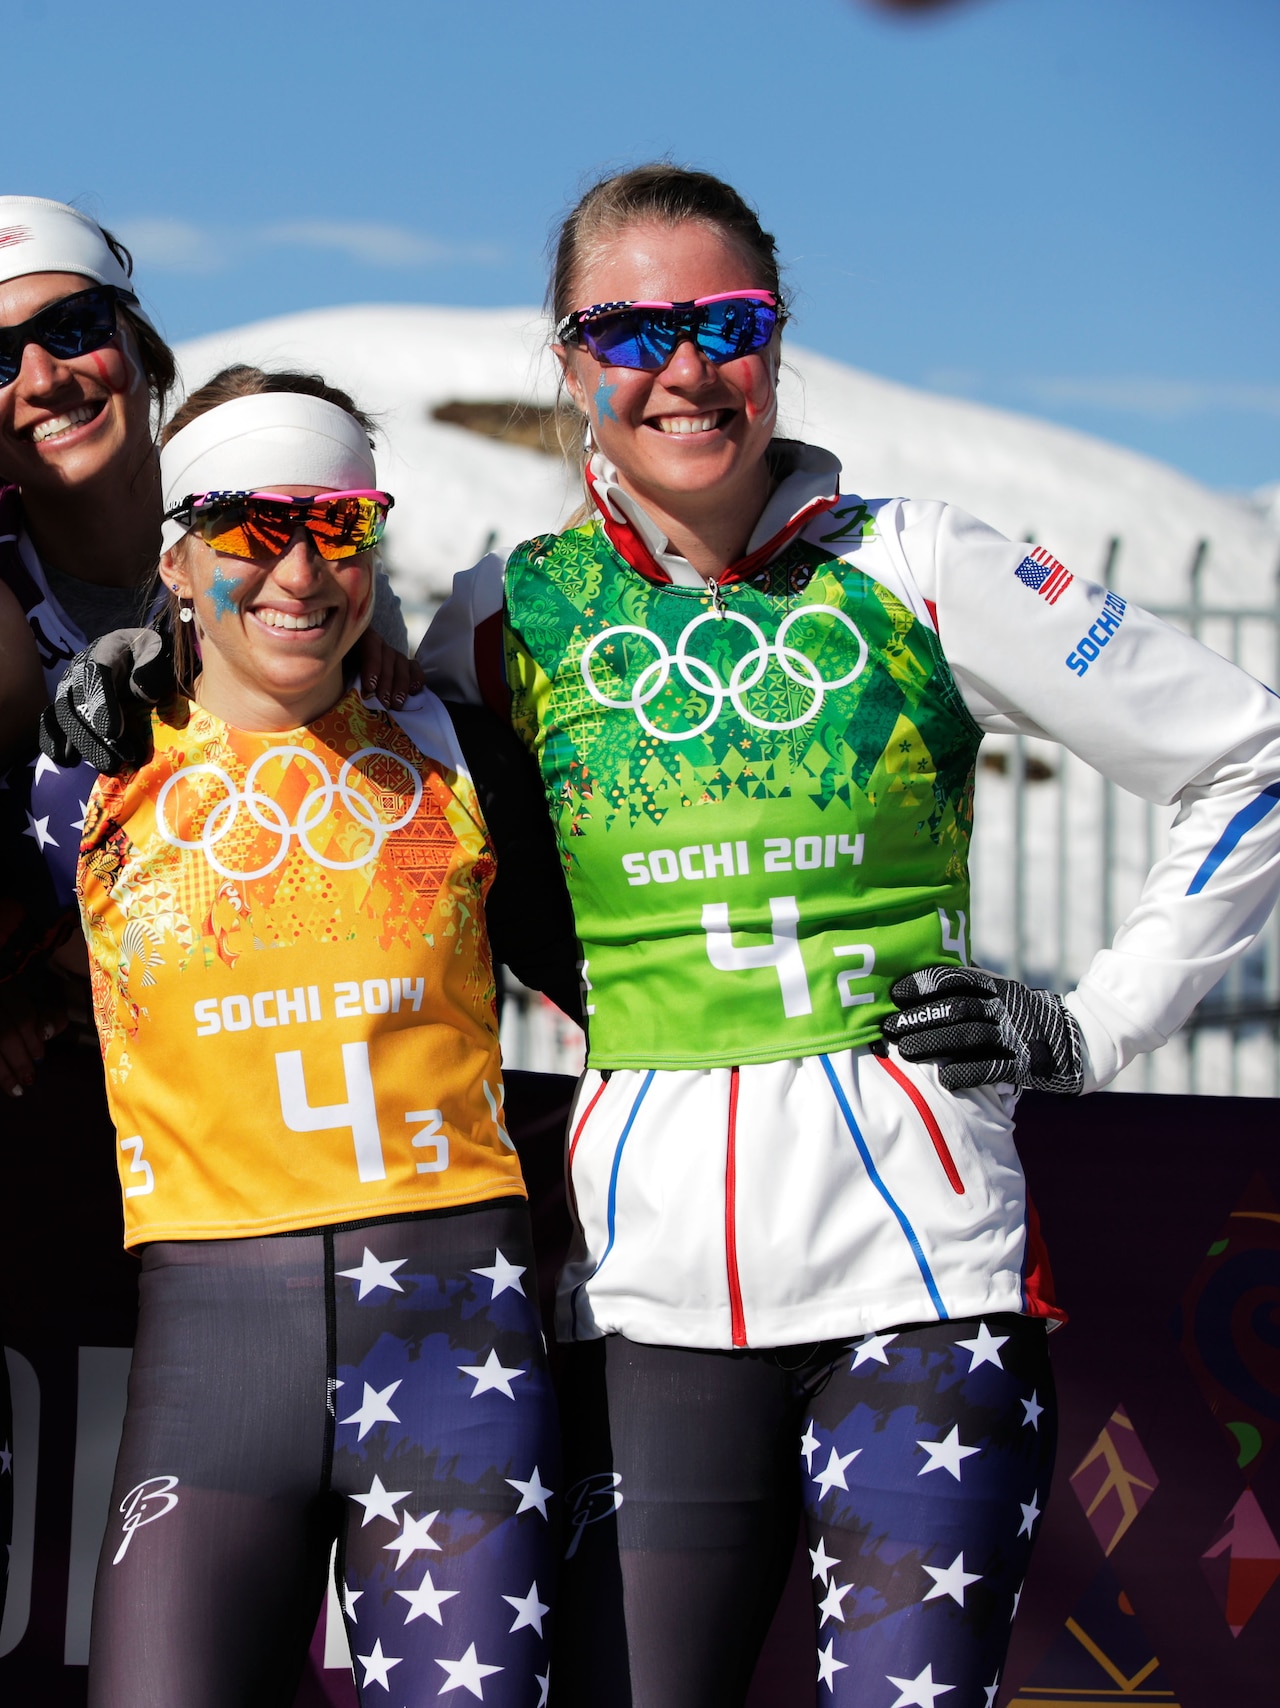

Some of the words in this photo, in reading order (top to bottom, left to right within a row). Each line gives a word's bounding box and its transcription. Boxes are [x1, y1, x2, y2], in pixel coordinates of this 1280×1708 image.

[1066, 607, 1123, 678] SOCHI
[1104, 590, 1127, 617] 201
[621, 840, 751, 886] SOCHI
[763, 833, 866, 873] 2014
[700, 895, 814, 1019] 4
[832, 943, 877, 1008] 2
[193, 985, 323, 1037] SOCHI
[333, 977, 425, 1019] 2014
[896, 1003, 952, 1028] Auclair
[274, 1041, 387, 1184] 4
[404, 1109, 450, 1174] 3
[120, 1135, 155, 1199] 3
